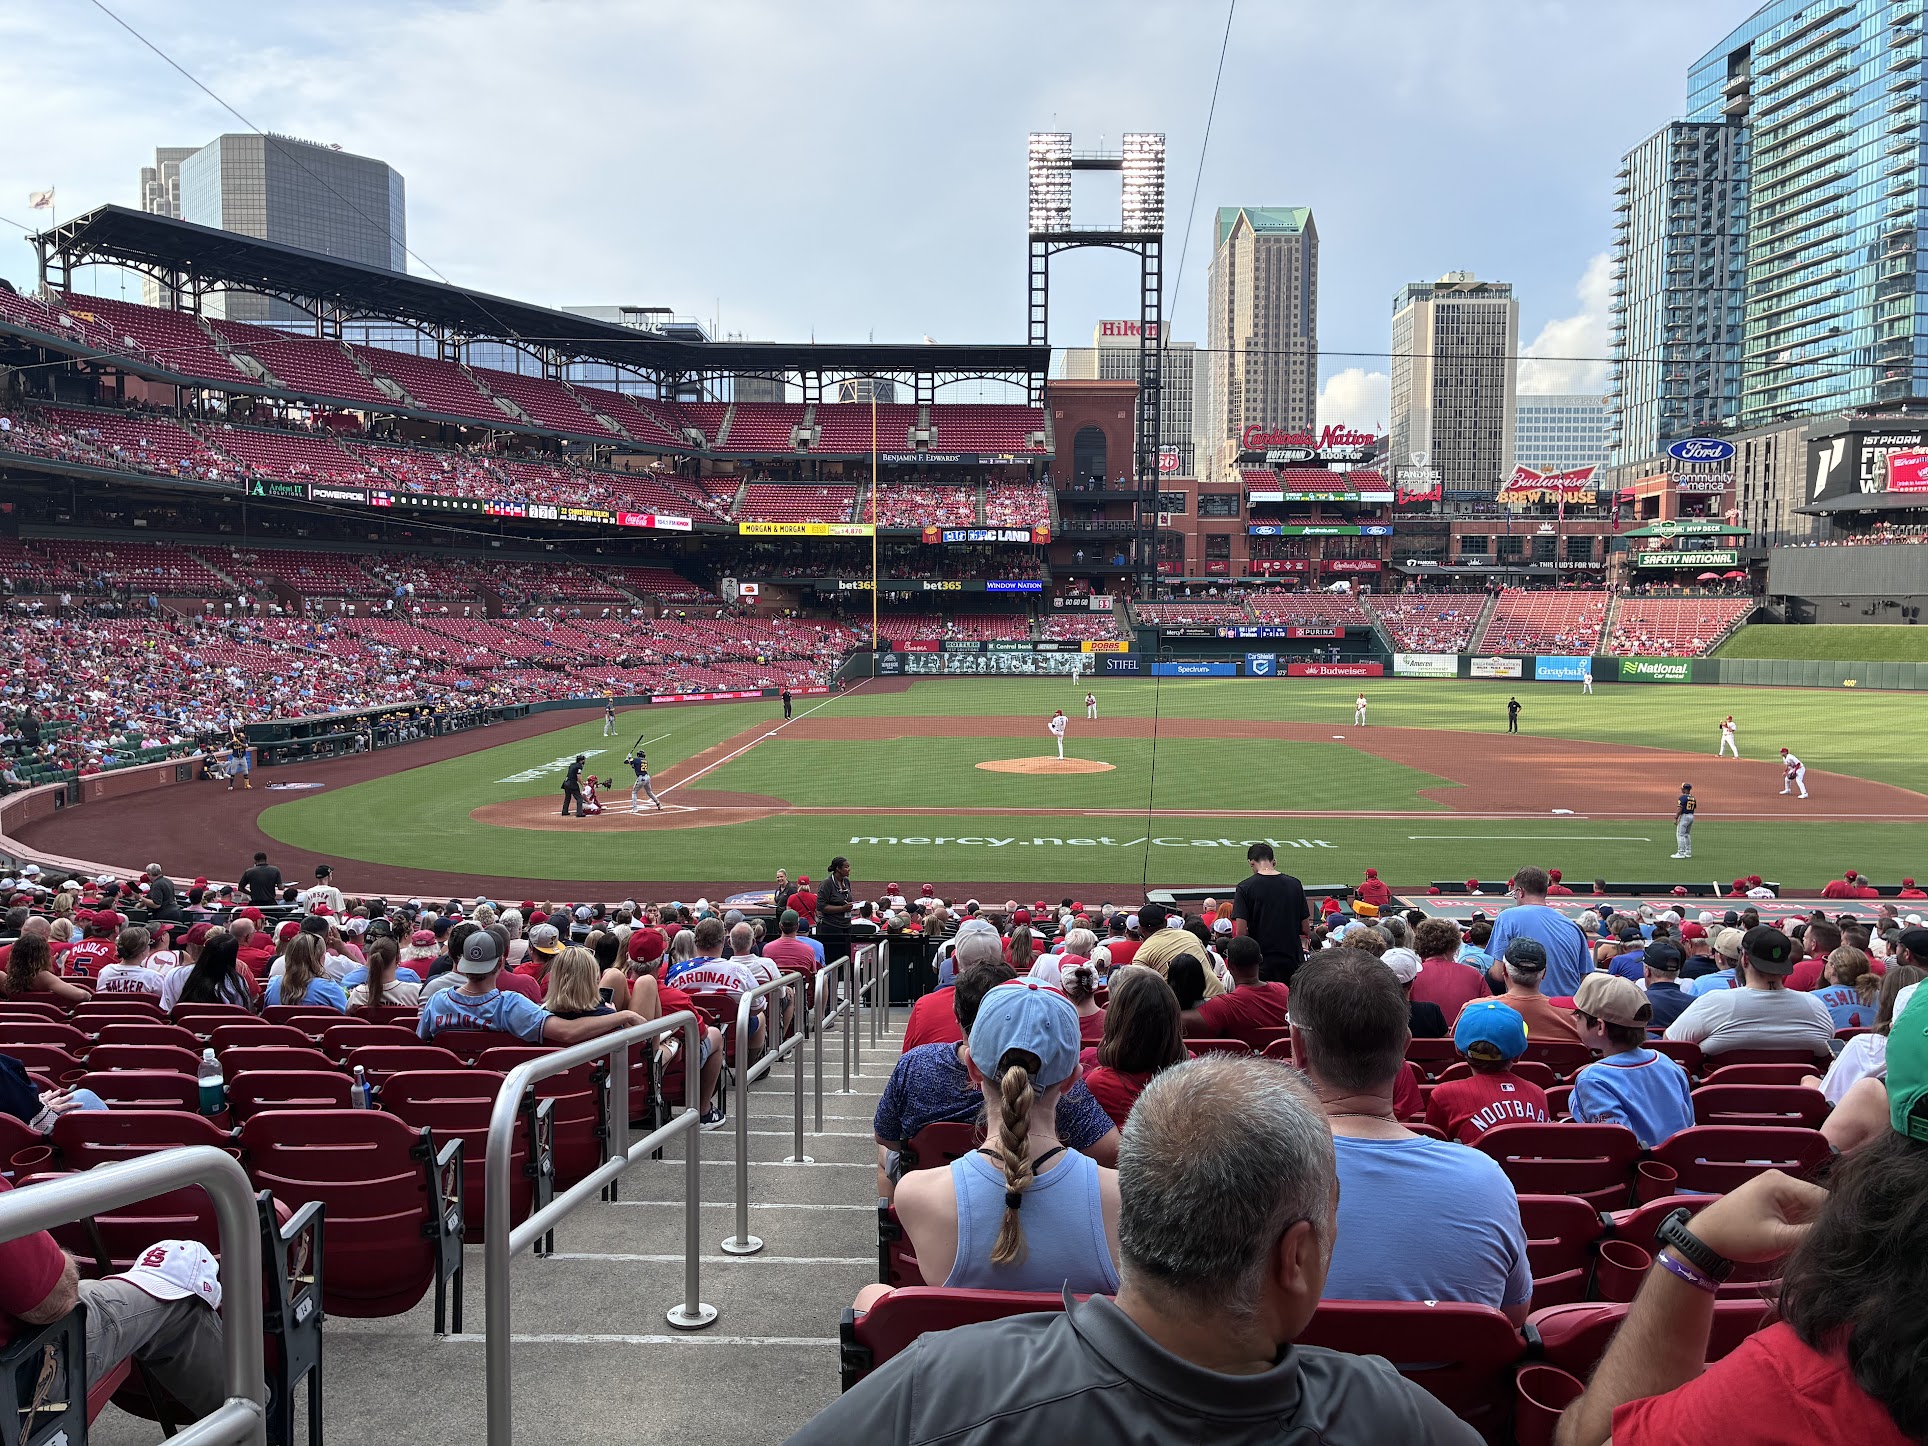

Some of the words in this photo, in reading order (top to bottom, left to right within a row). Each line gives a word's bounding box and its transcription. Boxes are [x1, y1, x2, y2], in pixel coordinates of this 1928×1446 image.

[1102, 321, 1158, 336] Hilton
[1243, 424, 1313, 449] Cardinals
[1314, 424, 1375, 450] Nation
[1880, 435, 1921, 444] PHORM
[1682, 441, 1723, 457] Ford
[883, 453, 917, 462] BENJAMIN
[926, 454, 959, 462] EDWARDS
[1266, 450, 1306, 459] HOFFMANN
[1320, 451, 1363, 460] ROOFTOP
[1672, 472, 1733, 483] Community
[269, 483, 293, 492] Ardent
[294, 485, 303, 493] IT
[269, 489, 304, 497] SOLUTIONS
[1398, 484, 1442, 504] Live!
[1498, 492, 1541, 503] BREW
[1545, 492, 1596, 503] HOUSE
[532, 509, 535, 517] 2
[568, 508, 593, 516] CHRISTIAN
[746, 525, 772, 533] MORGAN
[773, 525, 778, 533] &
[780, 525, 806, 533] MORGAN
[997, 531, 1030, 542] LAND
[1643, 555, 1680, 564] SAFETY
[1681, 554, 1732, 563] NATIONAL
[923, 580, 962, 590] bet365
[1106, 658, 1139, 670] STIFEL
[1178, 666, 1208, 674] Spectrum
[72, 941, 108, 956] PUJOLS
[73, 957, 93, 977] 5
[106, 979, 144, 992] WALKER
[671, 971, 741, 989] CARDINALS
[1470, 1100, 1551, 1132] NOOTBAA
